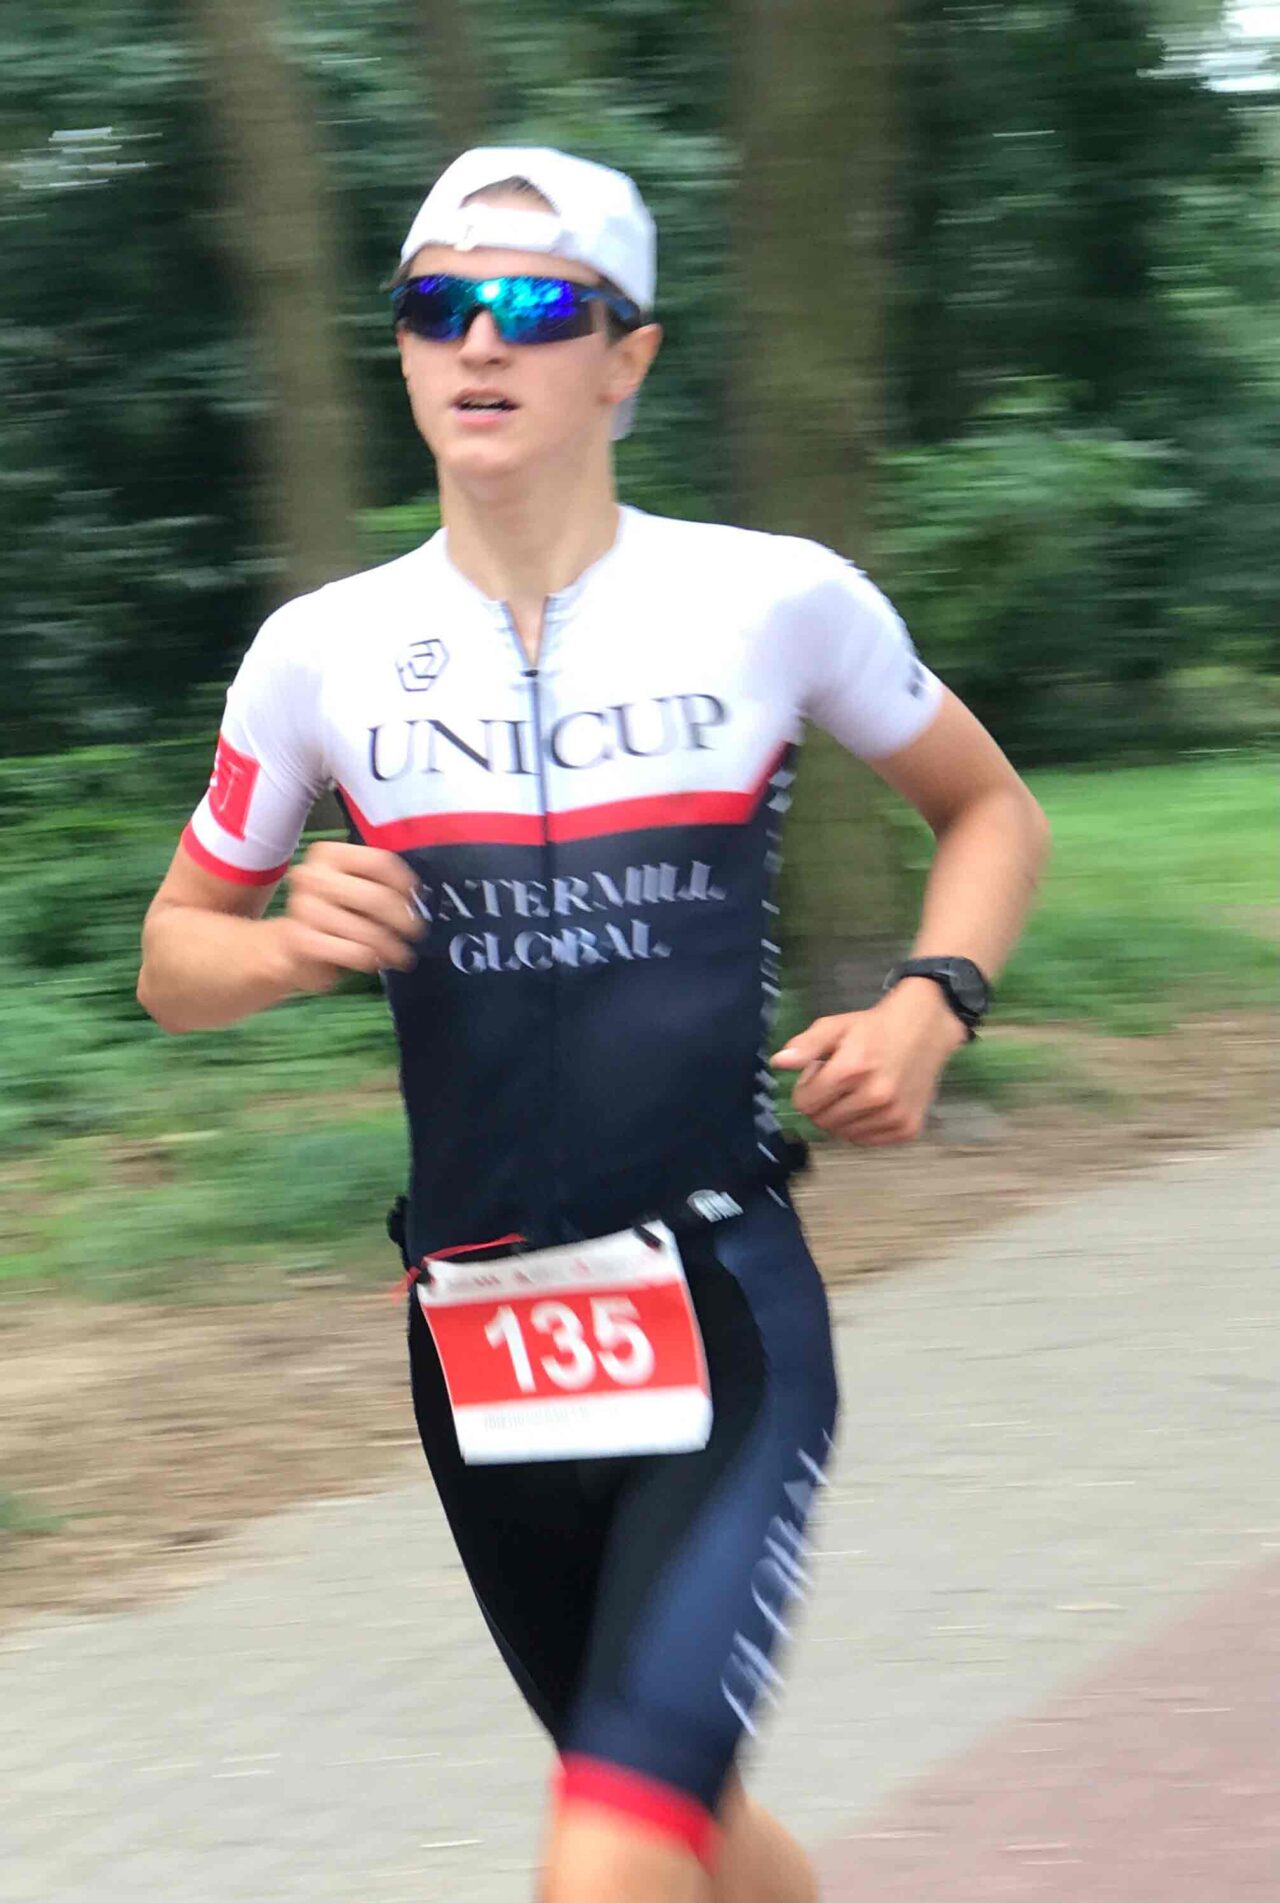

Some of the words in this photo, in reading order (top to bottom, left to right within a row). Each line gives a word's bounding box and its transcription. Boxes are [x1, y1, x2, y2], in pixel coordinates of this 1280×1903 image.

[368, 693, 729, 782] UNICUP
[449, 919, 671, 974] GLOBAL
[483, 1295, 655, 1393] 135
